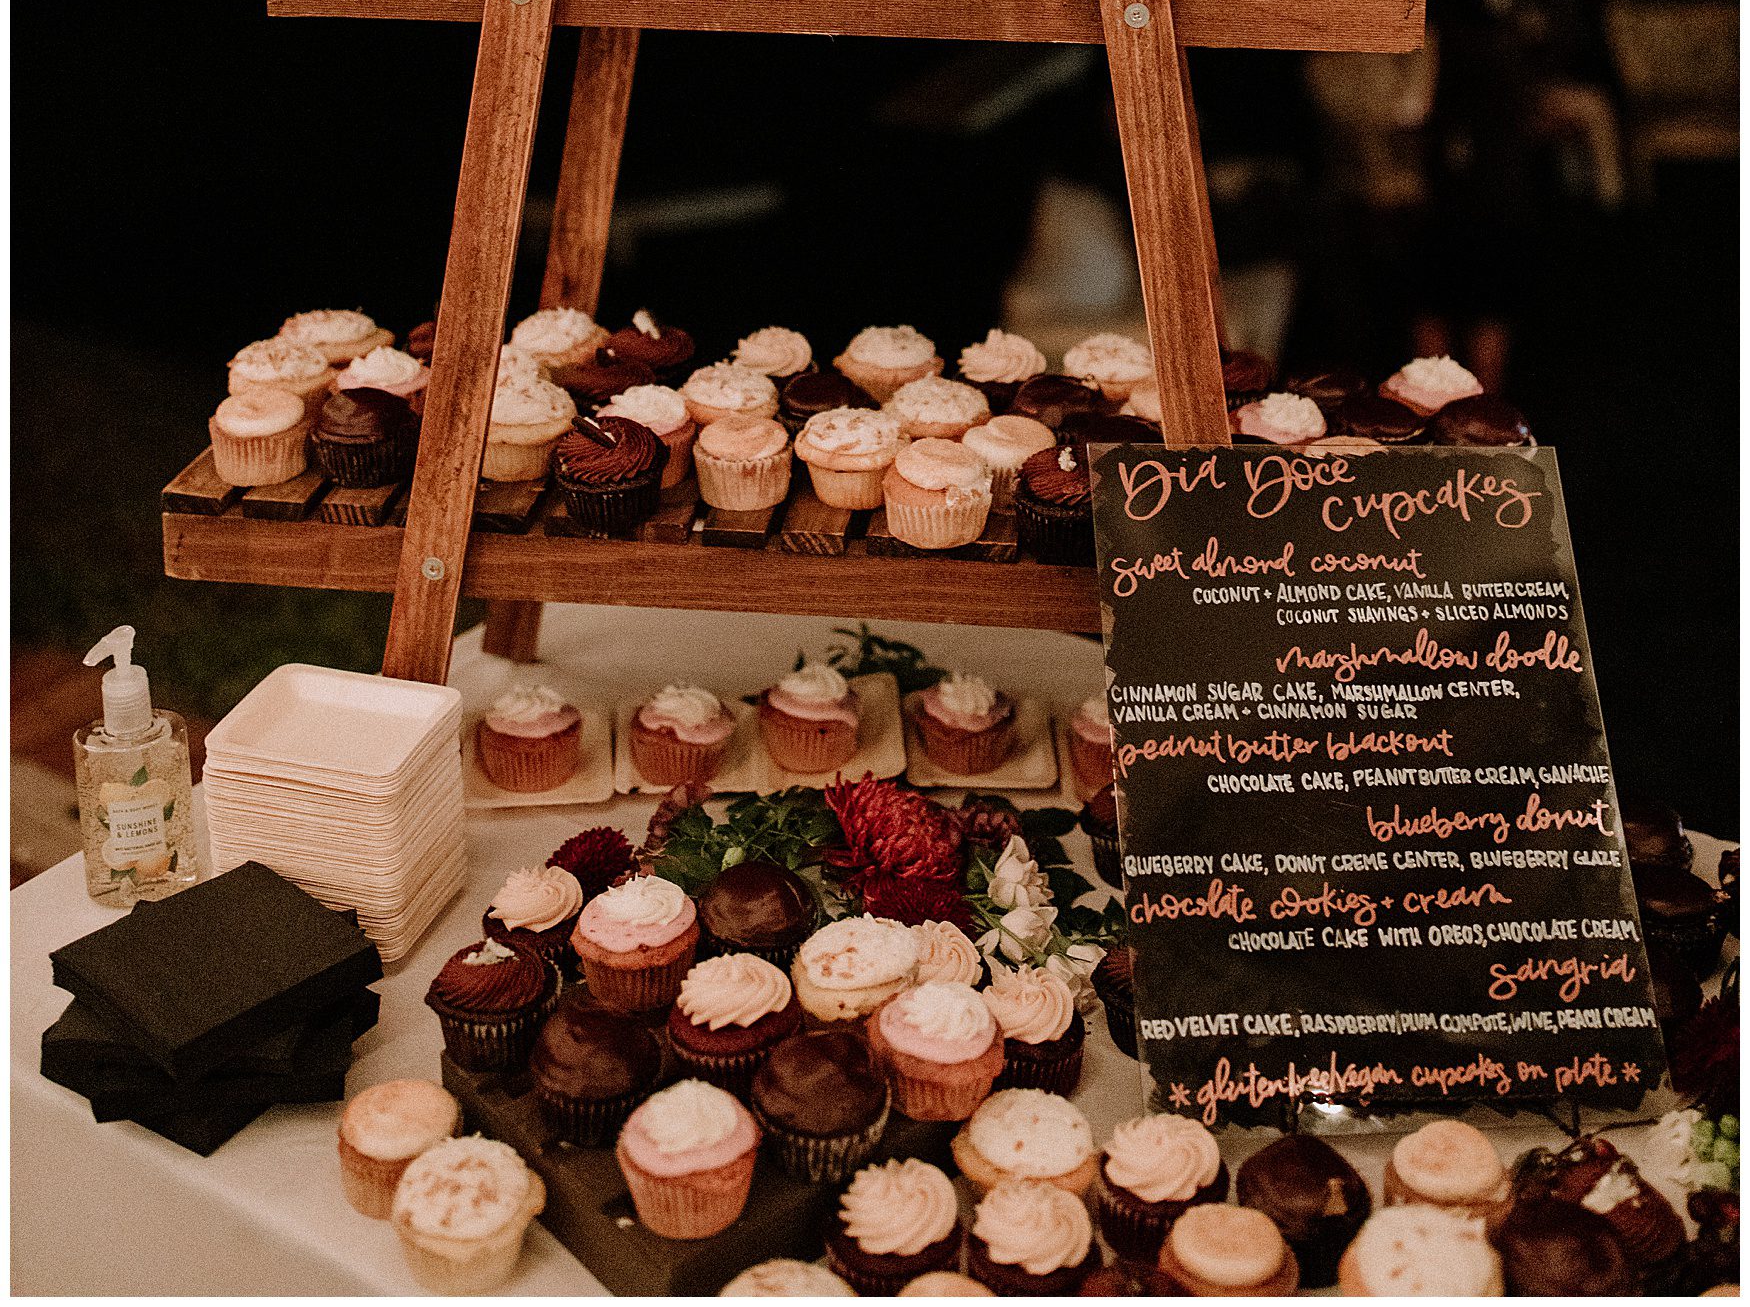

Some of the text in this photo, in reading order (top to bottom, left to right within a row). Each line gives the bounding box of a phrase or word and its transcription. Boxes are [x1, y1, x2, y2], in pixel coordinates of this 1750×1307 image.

[1118, 455, 1356, 521] Dia Doce
[1191, 536, 1295, 577] almond
[1311, 549, 1427, 578] coconut
[1193, 585, 1261, 605] COCONUT
[1276, 582, 1342, 604] ALMOND
[1345, 581, 1392, 603] CAKE,
[1393, 581, 1454, 600] VANILLA
[1276, 608, 1340, 625] COCONUT
[1347, 605, 1419, 623] SHAVINGS
[1435, 605, 1489, 622] SLICED
[1493, 602, 1569, 620] ALMONDS
[1276, 628, 1584, 682] marshmallow doodle
[1111, 678, 1521, 704] CINNAMON SUGAR CAKE, MARSHMALLOW CENTER,
[1113, 704, 1178, 724] VANILLA
[1182, 702, 1240, 722] CREAM
[1257, 702, 1348, 722] CINNAMON
[1357, 703, 1418, 720] SUGAR
[1117, 729, 1454, 779] peanut butter blackout
[1207, 773, 1296, 794] CHOCOLATE
[1300, 771, 1350, 793] CAKE,
[1474, 765, 1540, 790] CREAM,
[1538, 763, 1609, 784] GANACHE
[116, 818, 156, 831] SUNSHINE
[125, 825, 158, 839] LEMONS
[1365, 793, 1614, 843] blueberry donut
[1124, 849, 1622, 878] BLUEBERRY CAKE, DONUT CREME CENTER, BLUEBERRY GLAZE
[1130, 878, 1257, 924] chocolate
[1269, 881, 1378, 926] cookies
[1402, 883, 1513, 914] cream
[1227, 927, 1315, 952] CHOCOLATE
[1321, 926, 1369, 948] CAKE
[1377, 927, 1423, 947] WITH
[1486, 919, 1578, 944] CHOCOLATE
[1580, 918, 1641, 942] CREAM
[1488, 953, 1637, 1003] sangria
[1242, 1013, 1300, 1038] CAKE,
[1603, 1006, 1657, 1029] CREAM
[1410, 1052, 1512, 1095] cupcakes
[1516, 1060, 1549, 1082] on
[1554, 1052, 1618, 1094] plate
